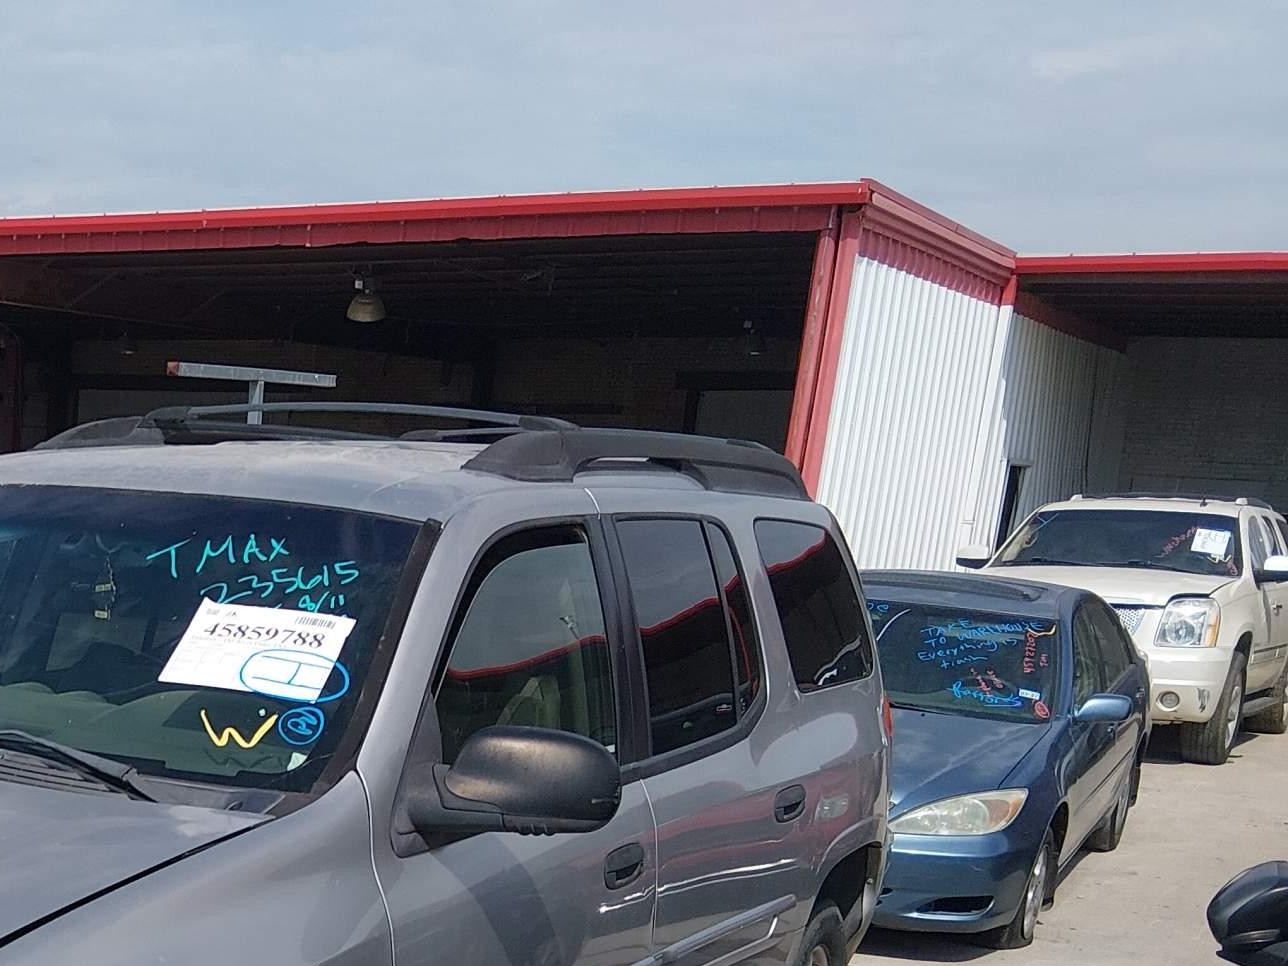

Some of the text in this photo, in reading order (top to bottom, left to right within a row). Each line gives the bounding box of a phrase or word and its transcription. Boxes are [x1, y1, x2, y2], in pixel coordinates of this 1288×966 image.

[203, 622, 327, 650] 45859788
[924, 637, 947, 648] TO
[199, 707, 280, 749] W
